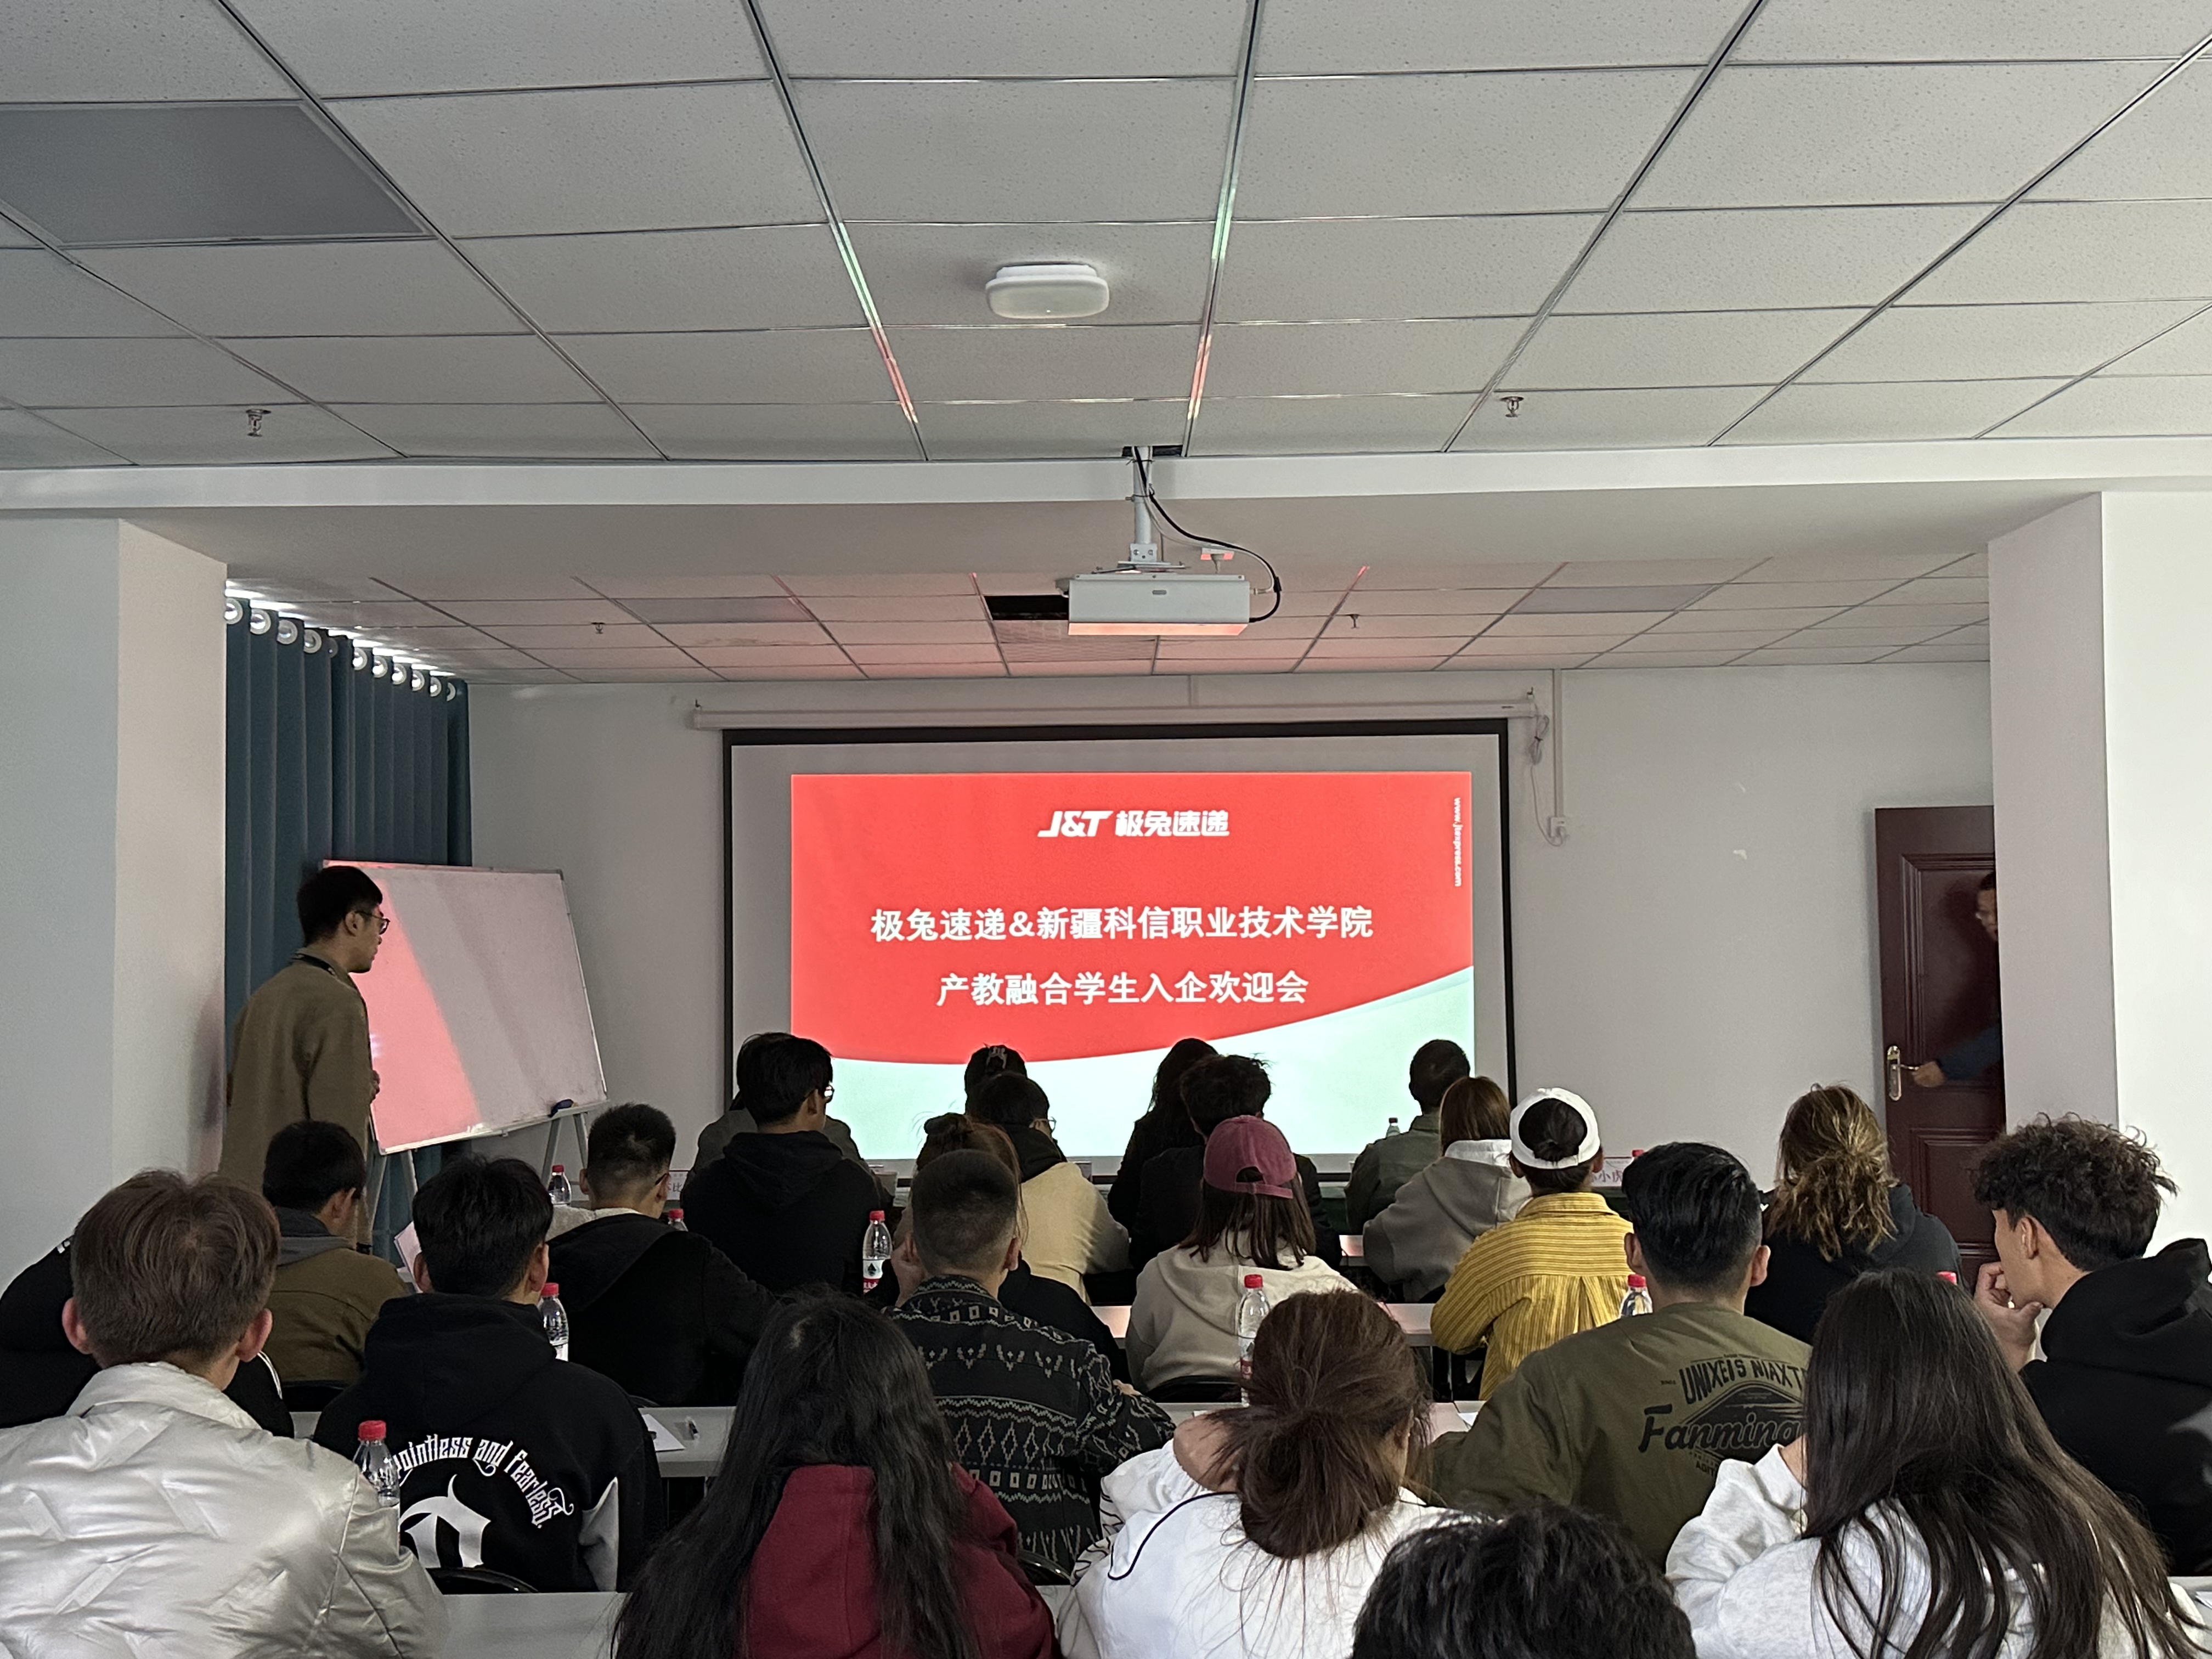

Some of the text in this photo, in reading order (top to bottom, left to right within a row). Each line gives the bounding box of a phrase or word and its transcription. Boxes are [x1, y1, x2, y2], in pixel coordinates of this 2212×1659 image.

[1037, 809, 1231, 838] J&T 极兔速递
[870, 905, 1374, 943] 极兔速递&新疆科信职业技术学院
[936, 969, 1310, 1007] 产教融合学生入企欢迎会
[472, 1439, 514, 1477] and
